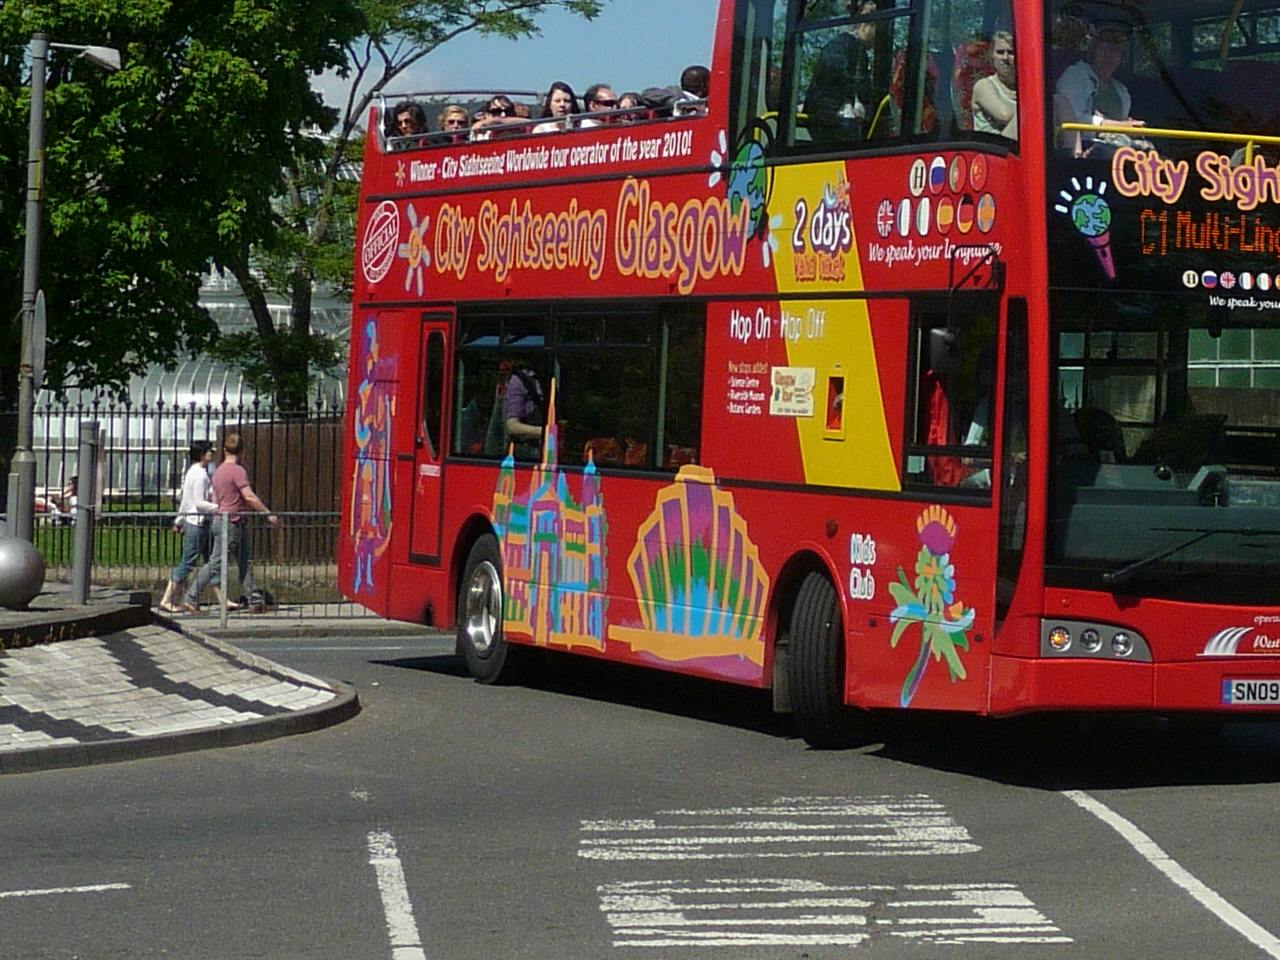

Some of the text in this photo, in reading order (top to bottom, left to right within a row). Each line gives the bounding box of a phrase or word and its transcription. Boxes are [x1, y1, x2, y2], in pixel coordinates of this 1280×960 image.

[411, 160, 437, 182] Winner
[442, 156, 459, 178] City
[459, 151, 506, 177] Sightseeing
[507, 145, 550, 172] Worldwide
[550, 146, 569, 168] tour
[570, 141, 609, 166] operator
[610, 137, 622, 162] of
[622, 136, 638, 161] the
[639, 137, 662, 160] year
[662, 129, 693, 157] 2010!
[1112, 146, 1189, 203] City
[434, 177, 751, 295] City Sightseeing Glasgow
[793, 199, 851, 254] 2 days
[869, 242, 885, 261] We
[885, 240, 915, 268] speak
[914, 244, 943, 266] your
[1209, 295, 1226, 307] We
[1227, 296, 1258, 310] speak
[730, 308, 752, 344] Hop
[755, 306, 771, 340] On
[780, 309, 802, 344] Hop
[807, 307, 826, 339] Off
[850, 533, 876, 565] Kids
[850, 568, 875, 600] Club
[1253, 635, 1280, 649] West
[1235, 682, 1280, 701] SN09
